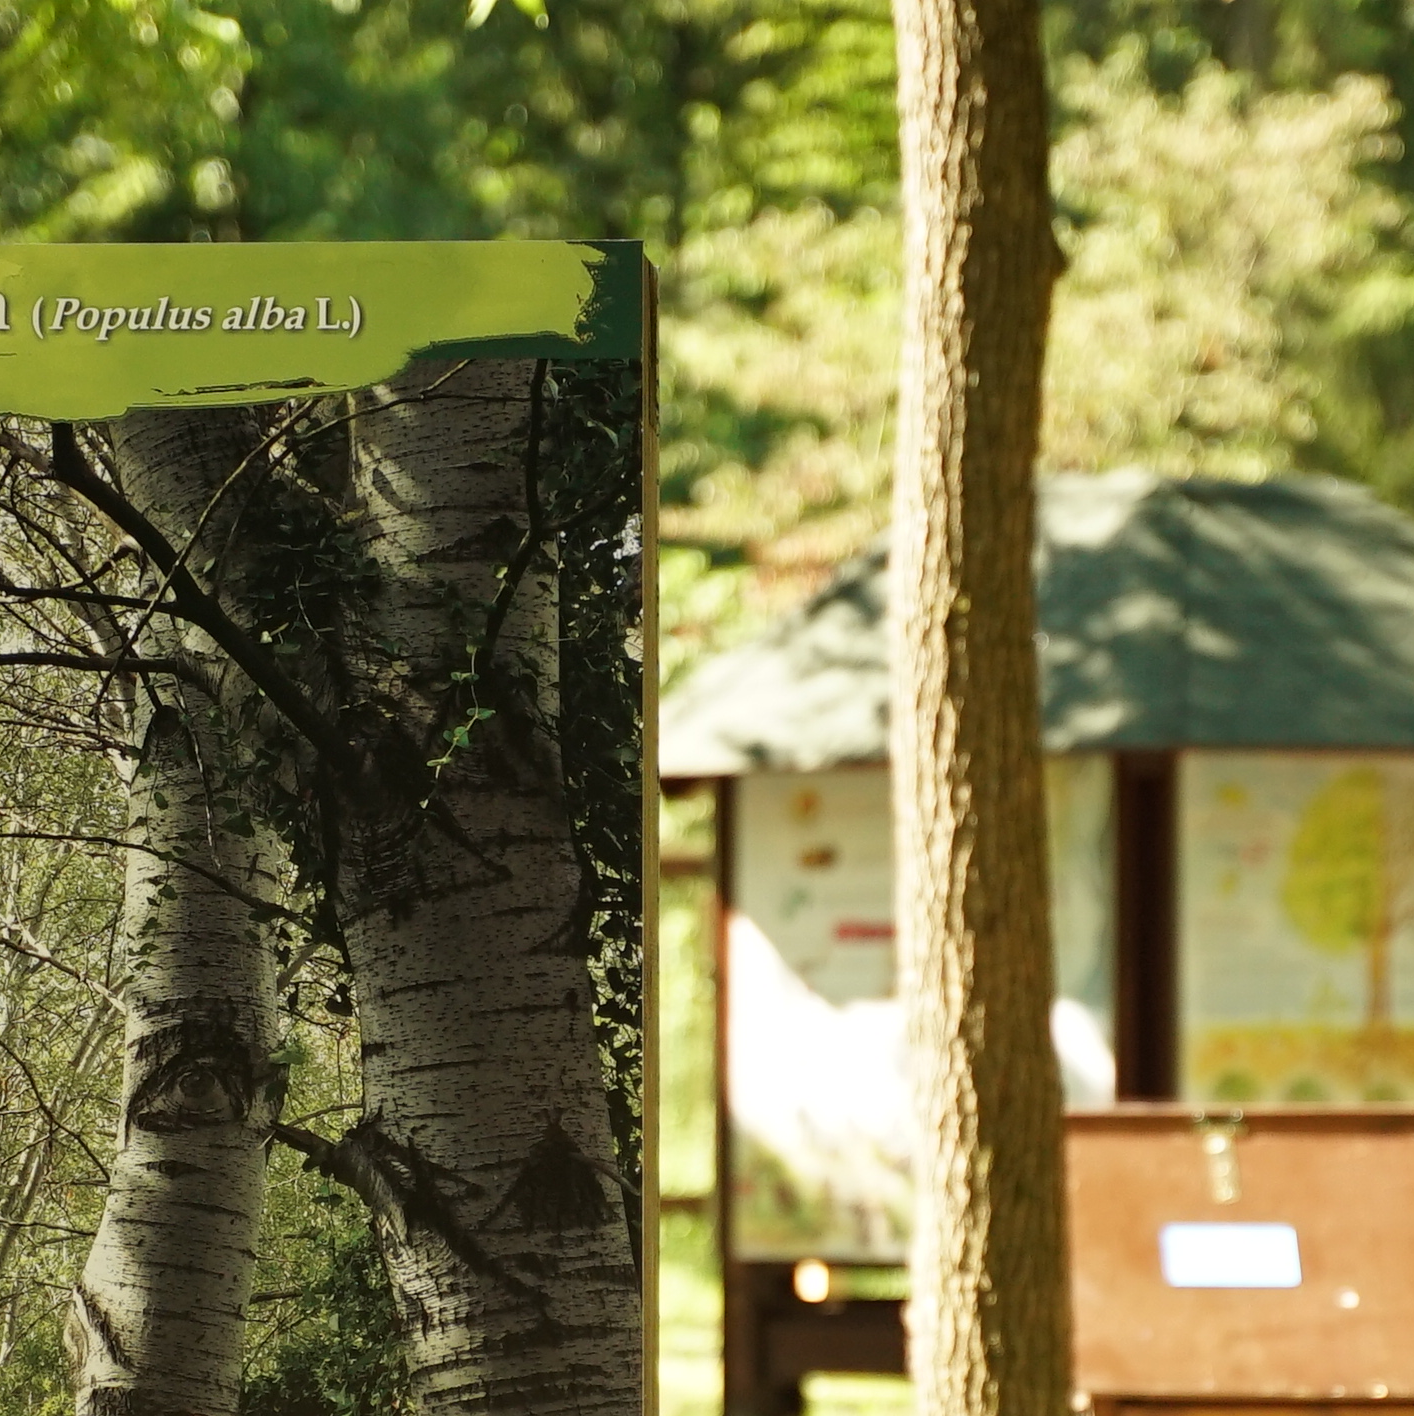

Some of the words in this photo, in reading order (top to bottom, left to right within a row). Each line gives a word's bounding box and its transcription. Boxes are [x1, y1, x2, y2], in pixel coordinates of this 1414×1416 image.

[32, 295, 212, 341] (Populus
[222, 296, 305, 330] alba
[315, 295, 364, 338] L.)
